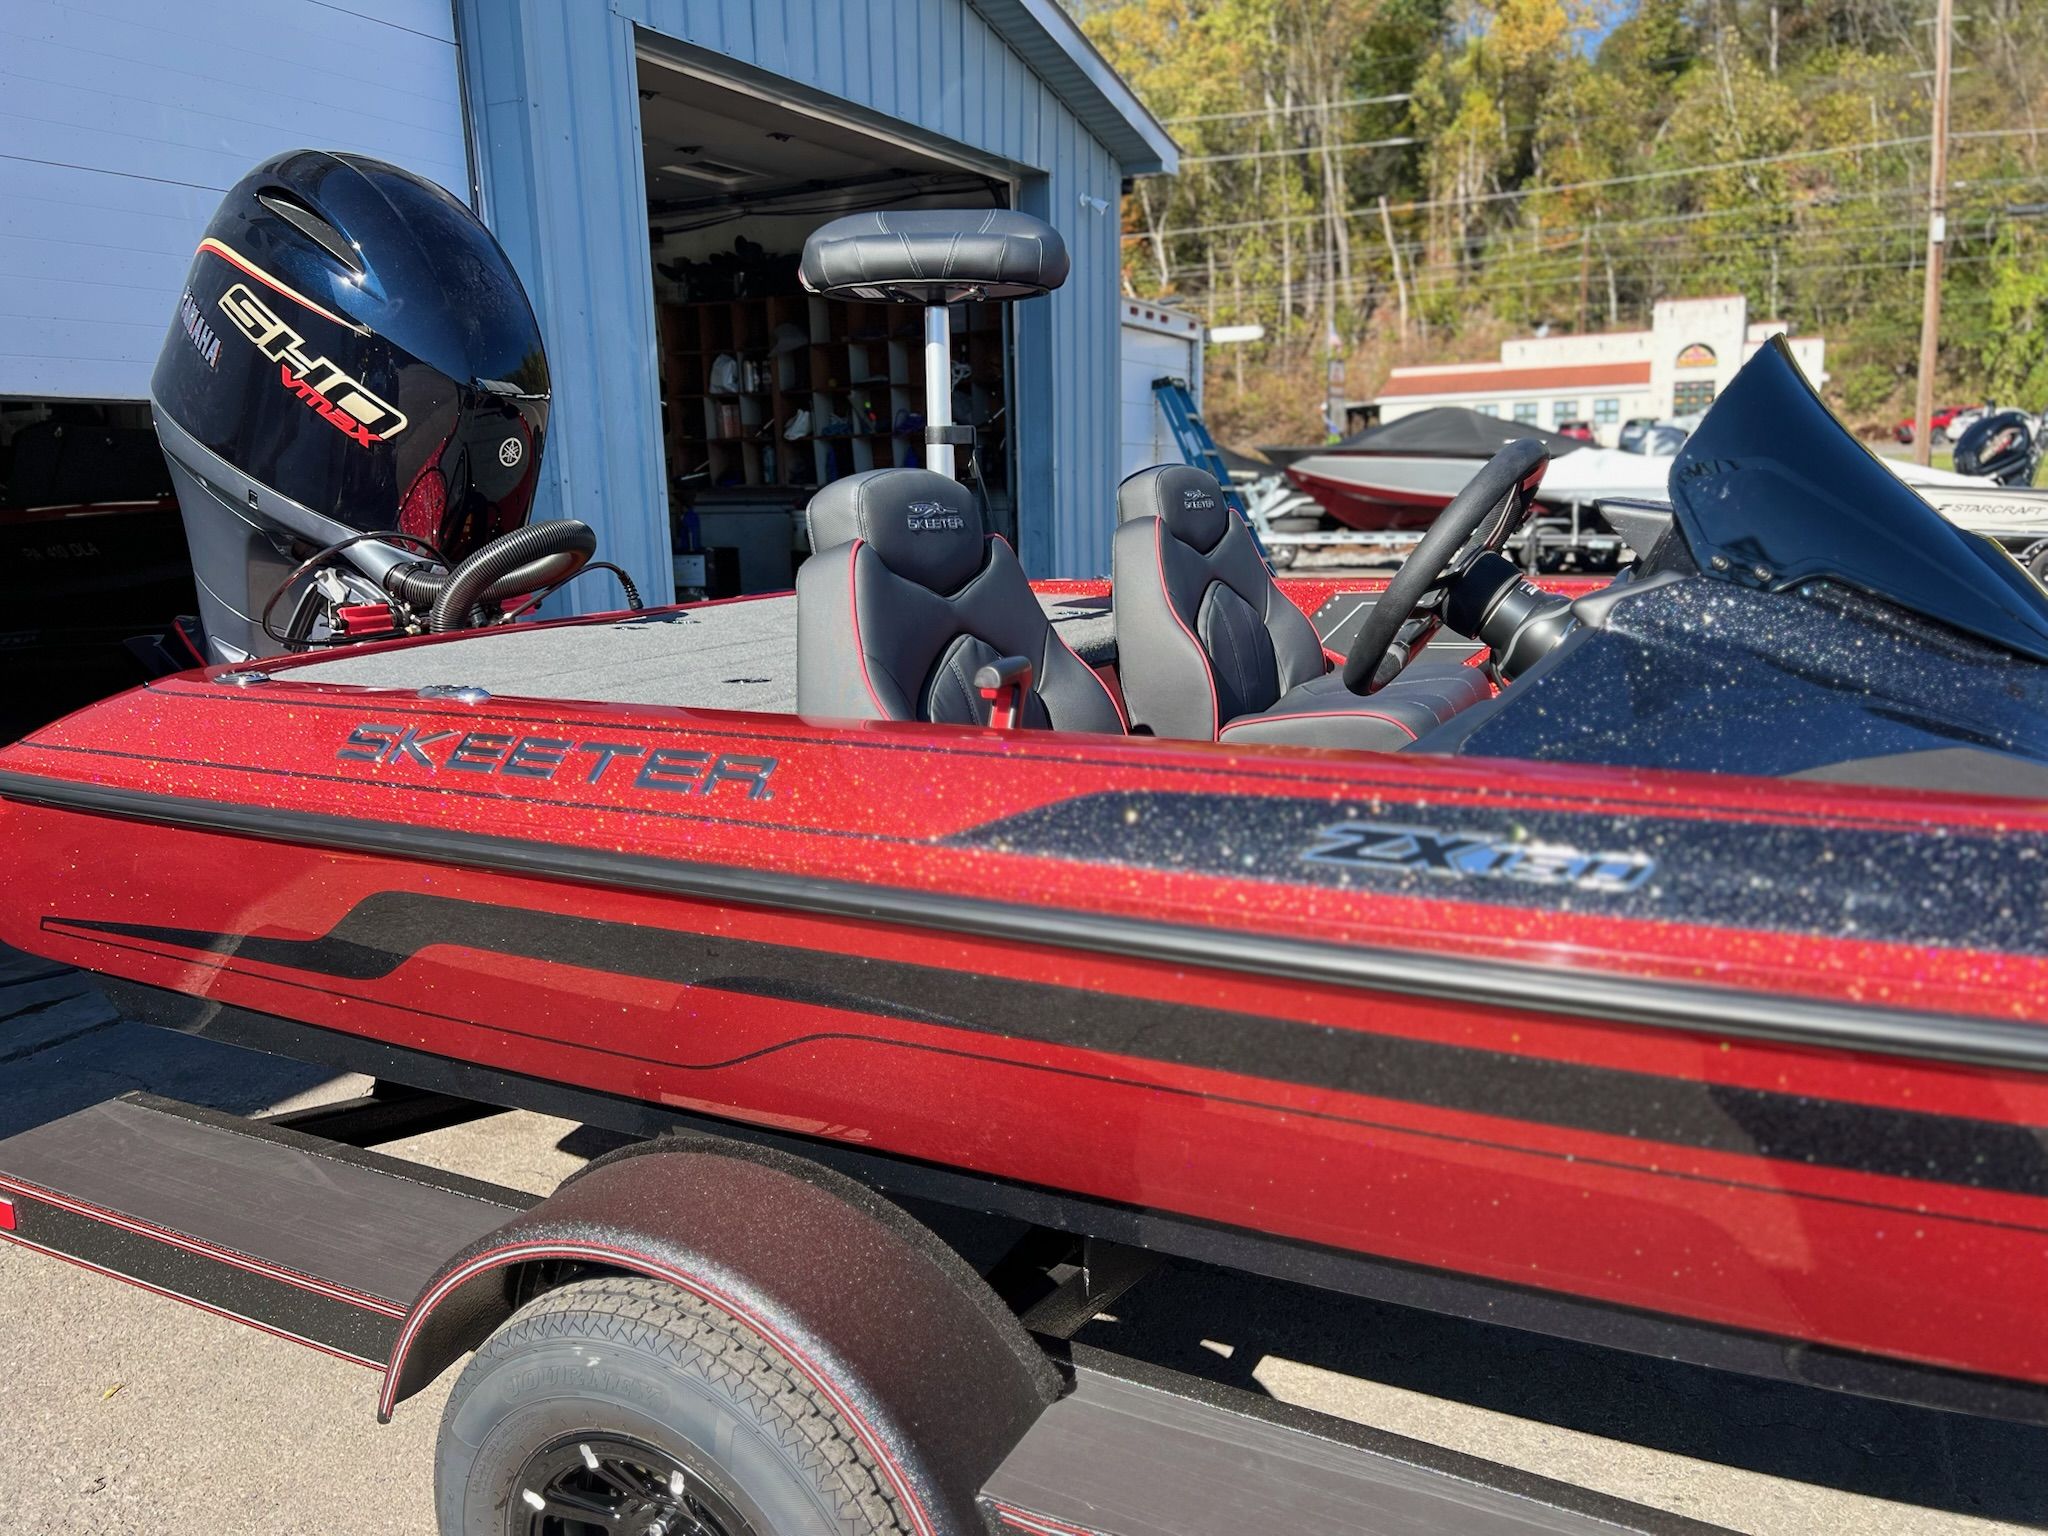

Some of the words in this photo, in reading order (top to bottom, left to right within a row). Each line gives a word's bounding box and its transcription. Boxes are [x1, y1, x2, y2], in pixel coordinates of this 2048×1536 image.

[181, 286, 221, 369] YAMAHA
[217, 282, 409, 440] SHO
[907, 516, 965, 530] SKEETER
[1951, 503, 2047, 515] STARCRAFT
[336, 723, 778, 801] SKEETER
